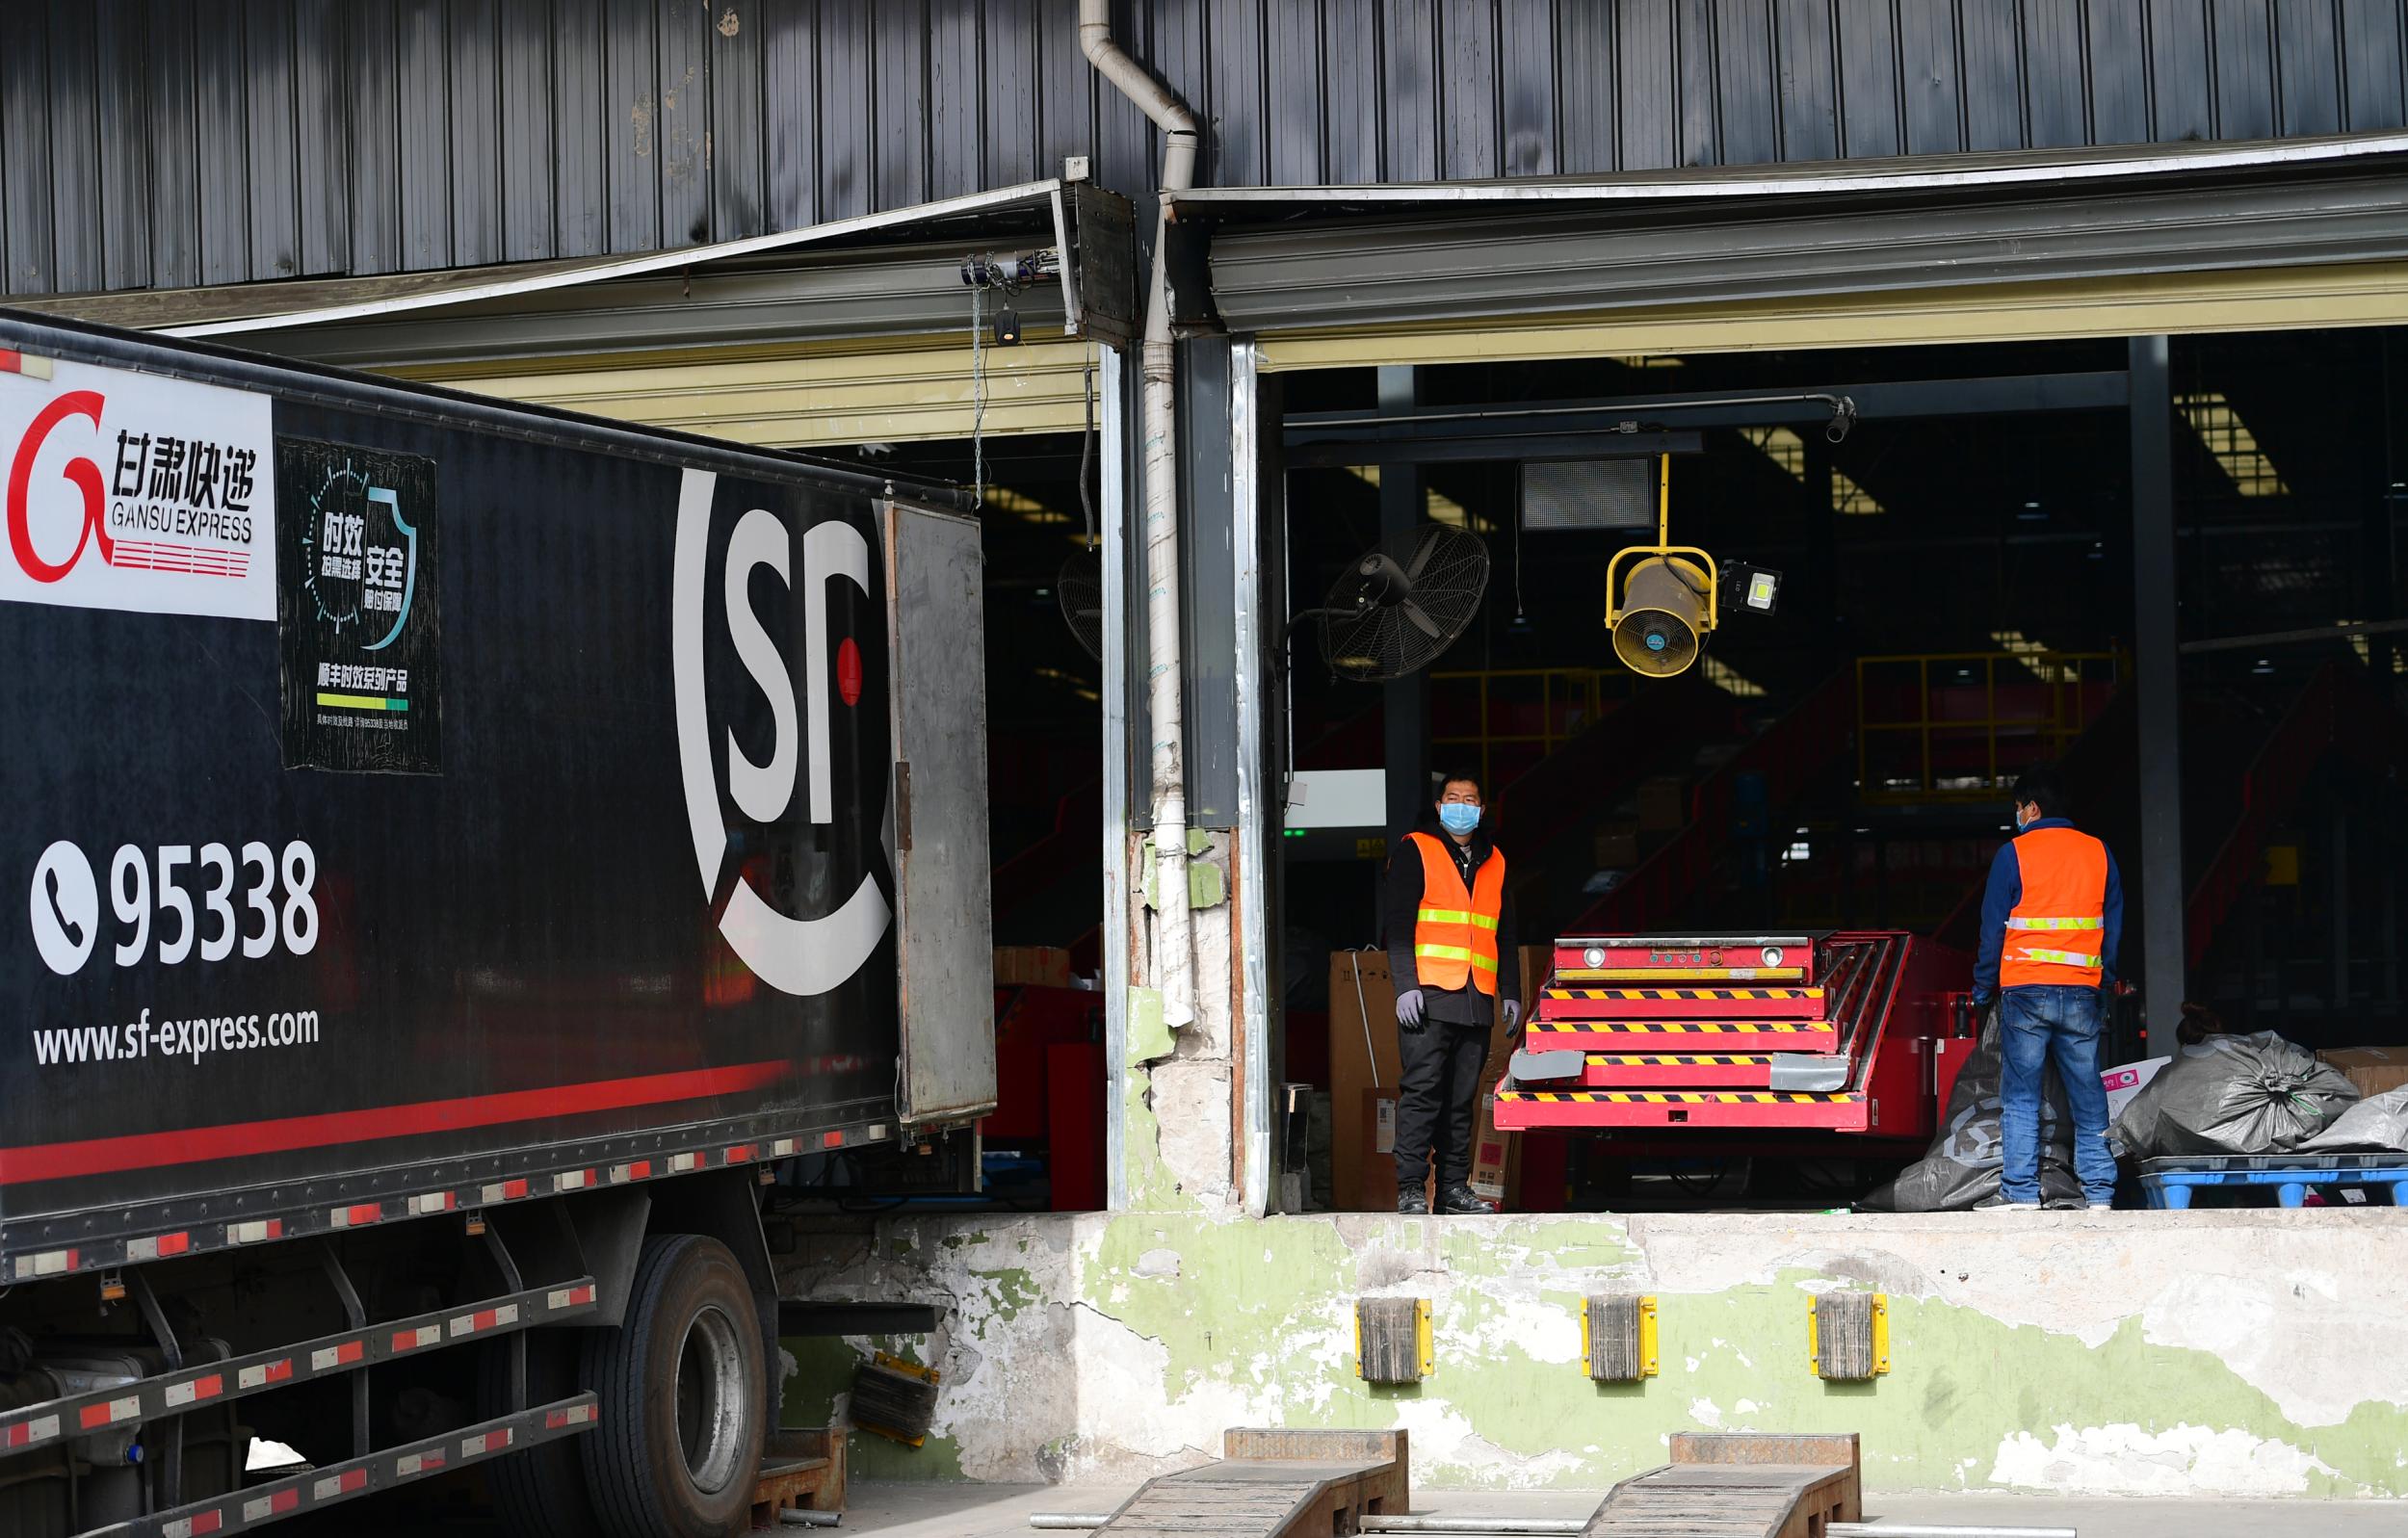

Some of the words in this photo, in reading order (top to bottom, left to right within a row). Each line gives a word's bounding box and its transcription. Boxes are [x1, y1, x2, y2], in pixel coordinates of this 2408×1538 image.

[112, 430, 256, 512] 甘肃快递
[112, 502, 171, 533] GANSU
[176, 508, 251, 544] EXPRESS
[323, 511, 364, 557] 时效
[321, 555, 361, 580] 按需选择
[365, 545, 404, 588] 安全
[364, 588, 403, 612] 赔付保障
[317, 662, 407, 692] 顺丰时效系列产品
[110, 839, 319, 967] 95338
[33, 1007, 319, 1065] www.sf-express.com
